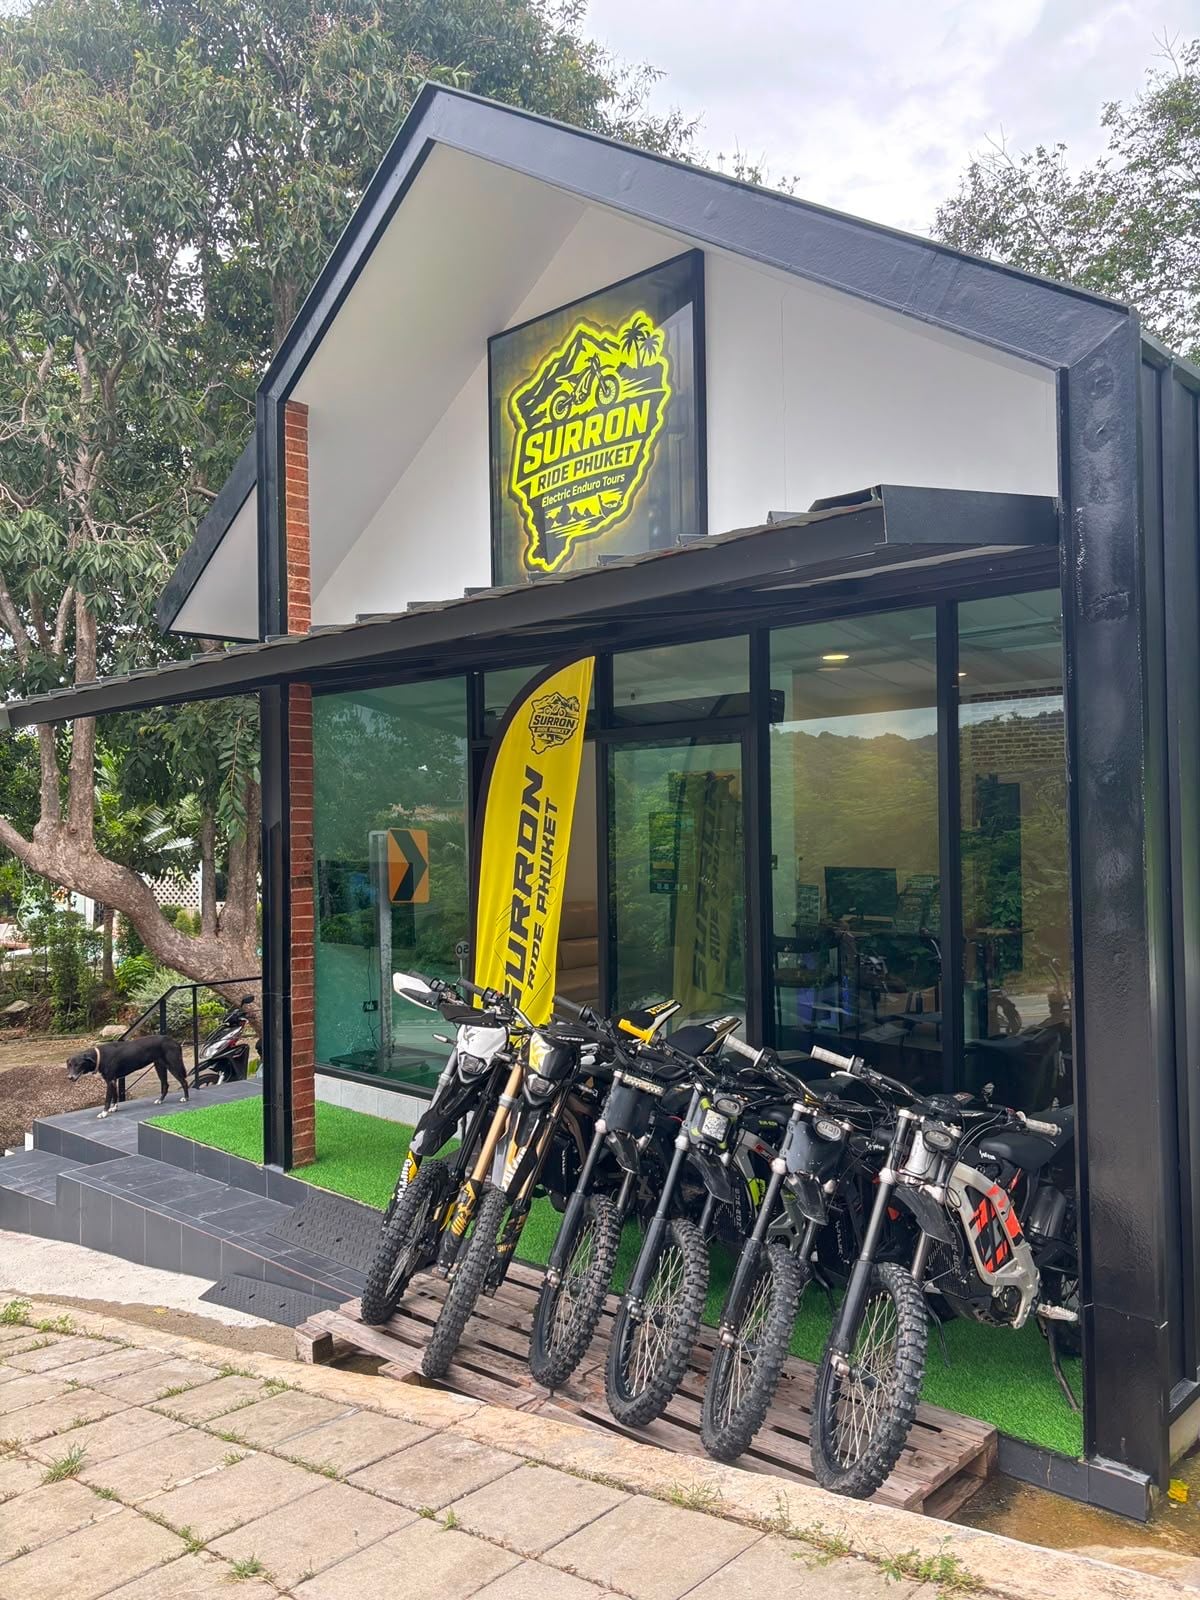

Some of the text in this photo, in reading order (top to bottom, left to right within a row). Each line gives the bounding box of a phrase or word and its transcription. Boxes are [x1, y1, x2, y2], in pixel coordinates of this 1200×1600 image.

[523, 400, 650, 474] SURRON
[537, 445, 634, 492] RIDE PHUKET
[541, 473, 626, 508] Electric Enduro Tours
[533, 714, 576, 729] SURRON
[526, 796, 558, 991] RIDE PHUKET
